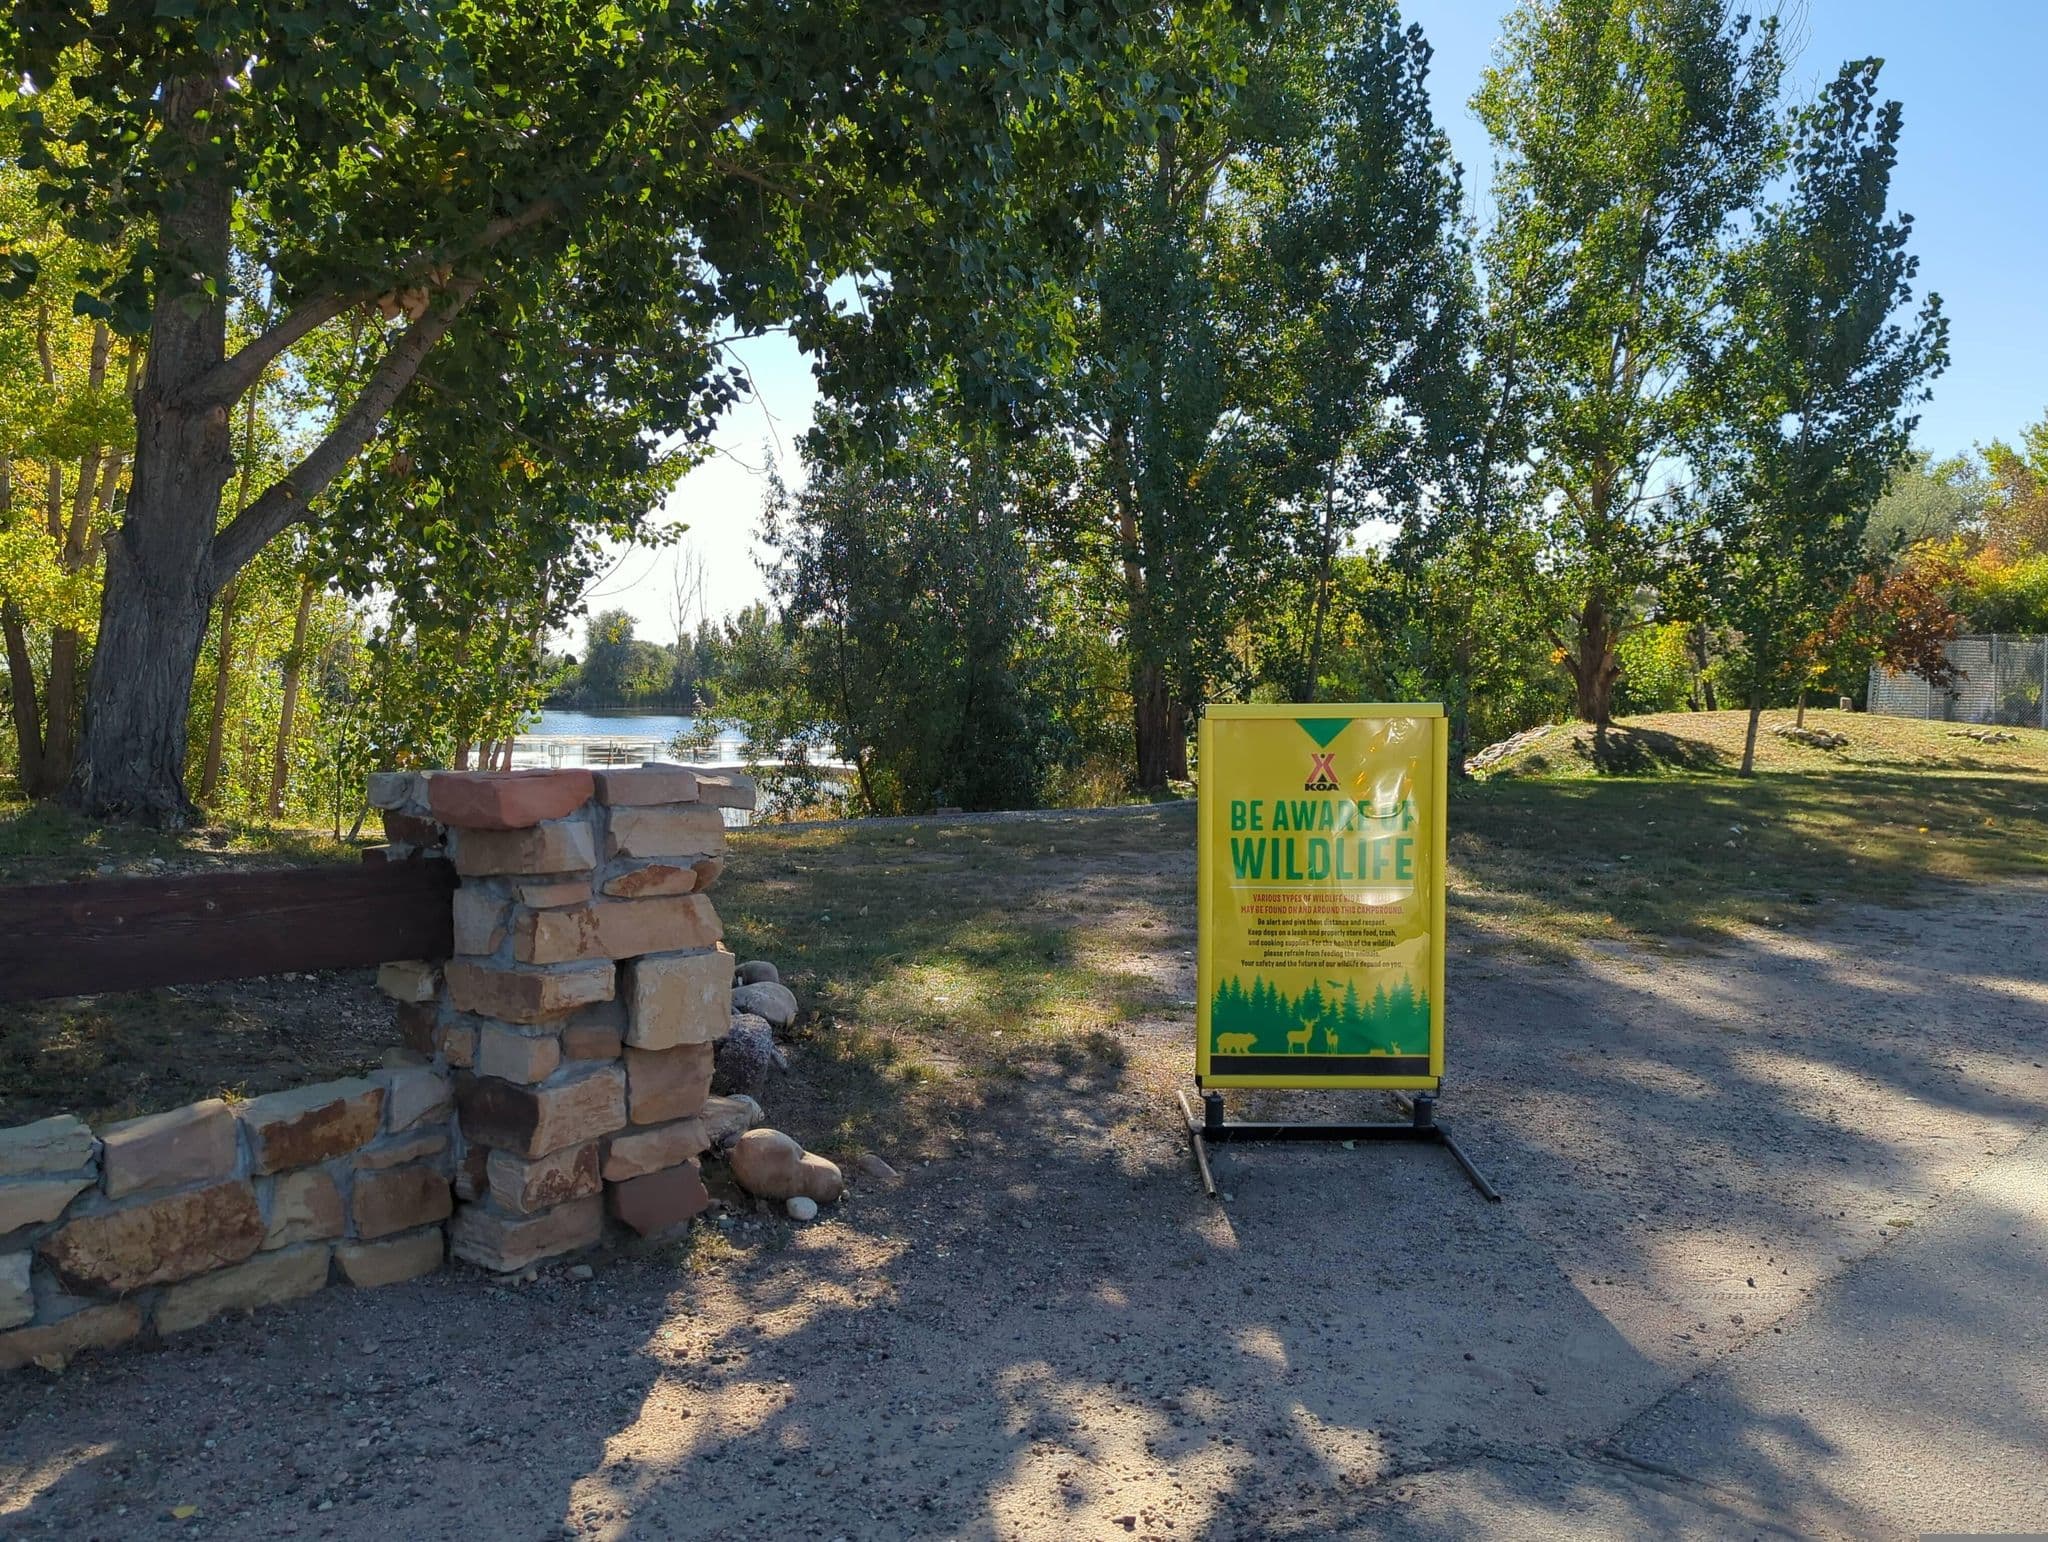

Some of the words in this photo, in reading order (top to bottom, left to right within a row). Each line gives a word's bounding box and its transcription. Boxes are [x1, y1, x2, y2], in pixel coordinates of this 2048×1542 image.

[1305, 783, 1340, 791] KOA
[1231, 800, 1264, 831] BE
[1231, 837, 1413, 880] WILDLIFE
[1253, 894, 1280, 902] VARIOUS
[1282, 894, 1302, 902] TYPES
[1294, 918, 1306, 926] give
[1248, 929, 1262, 937] Keep
[1263, 929, 1277, 937] dogs
[1321, 929, 1345, 937] properly
[1261, 939, 1283, 947] cooking
[1264, 949, 1283, 957] please
[1321, 949, 1343, 958] feeding
[1256, 960, 1274, 968] safety
